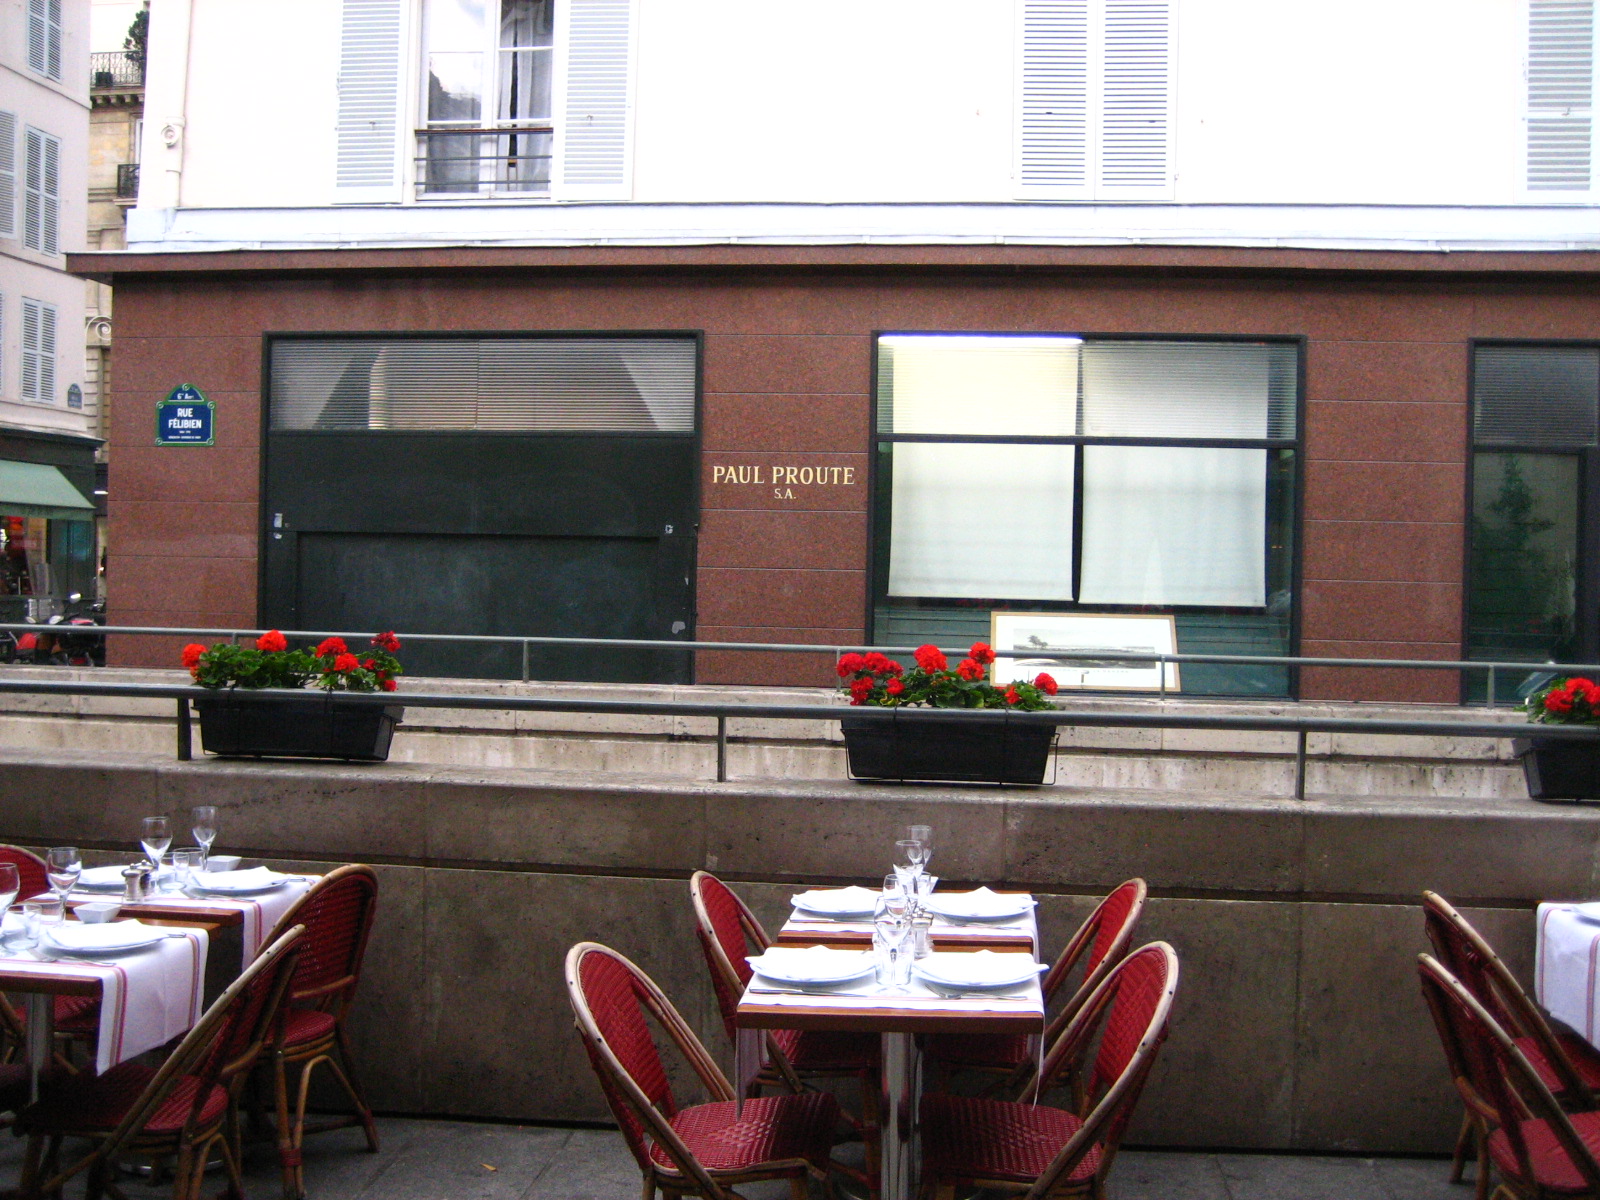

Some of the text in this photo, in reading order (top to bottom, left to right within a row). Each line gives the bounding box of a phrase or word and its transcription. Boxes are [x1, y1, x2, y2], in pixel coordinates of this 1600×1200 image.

[177, 408, 193, 417] RUE
[168, 418, 202, 429] FÉLIBIEN
[713, 465, 855, 485] PAUL PROUTE
